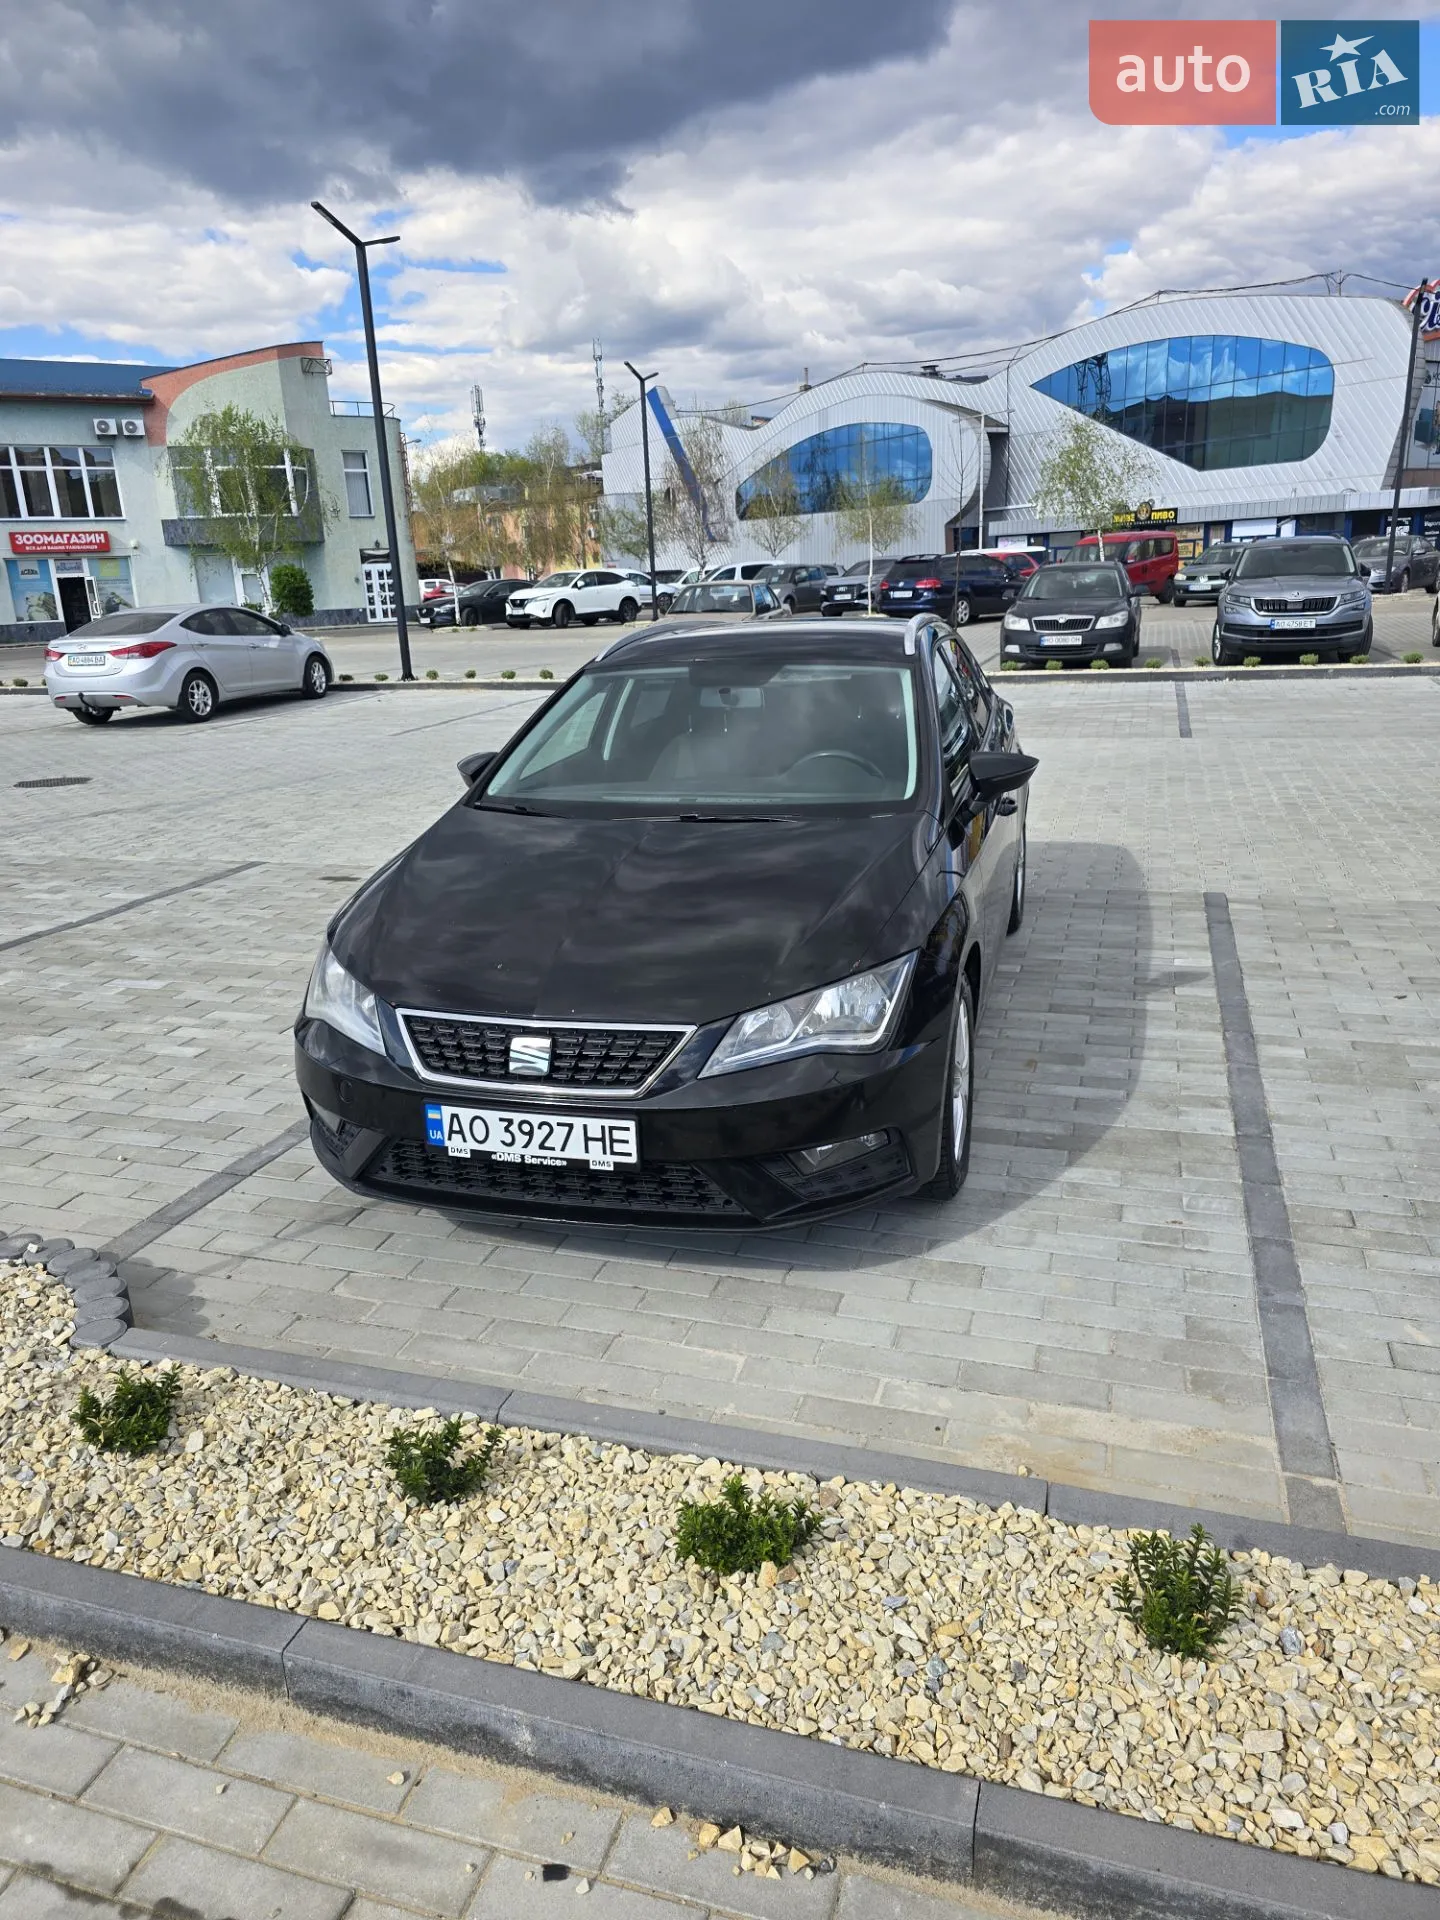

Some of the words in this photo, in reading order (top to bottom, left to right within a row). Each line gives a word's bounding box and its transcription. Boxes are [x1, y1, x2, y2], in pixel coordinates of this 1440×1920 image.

[1151, 510, 1175, 520] ПИВО
[15, 533, 105, 545] ЗООМАГАЗИН
[429, 1129, 443, 1139] UA
[447, 1113, 490, 1144] AO
[498, 1117, 574, 1152] 3927
[582, 1123, 633, 1157] HE
[591, 1160, 612, 1168] DMS
